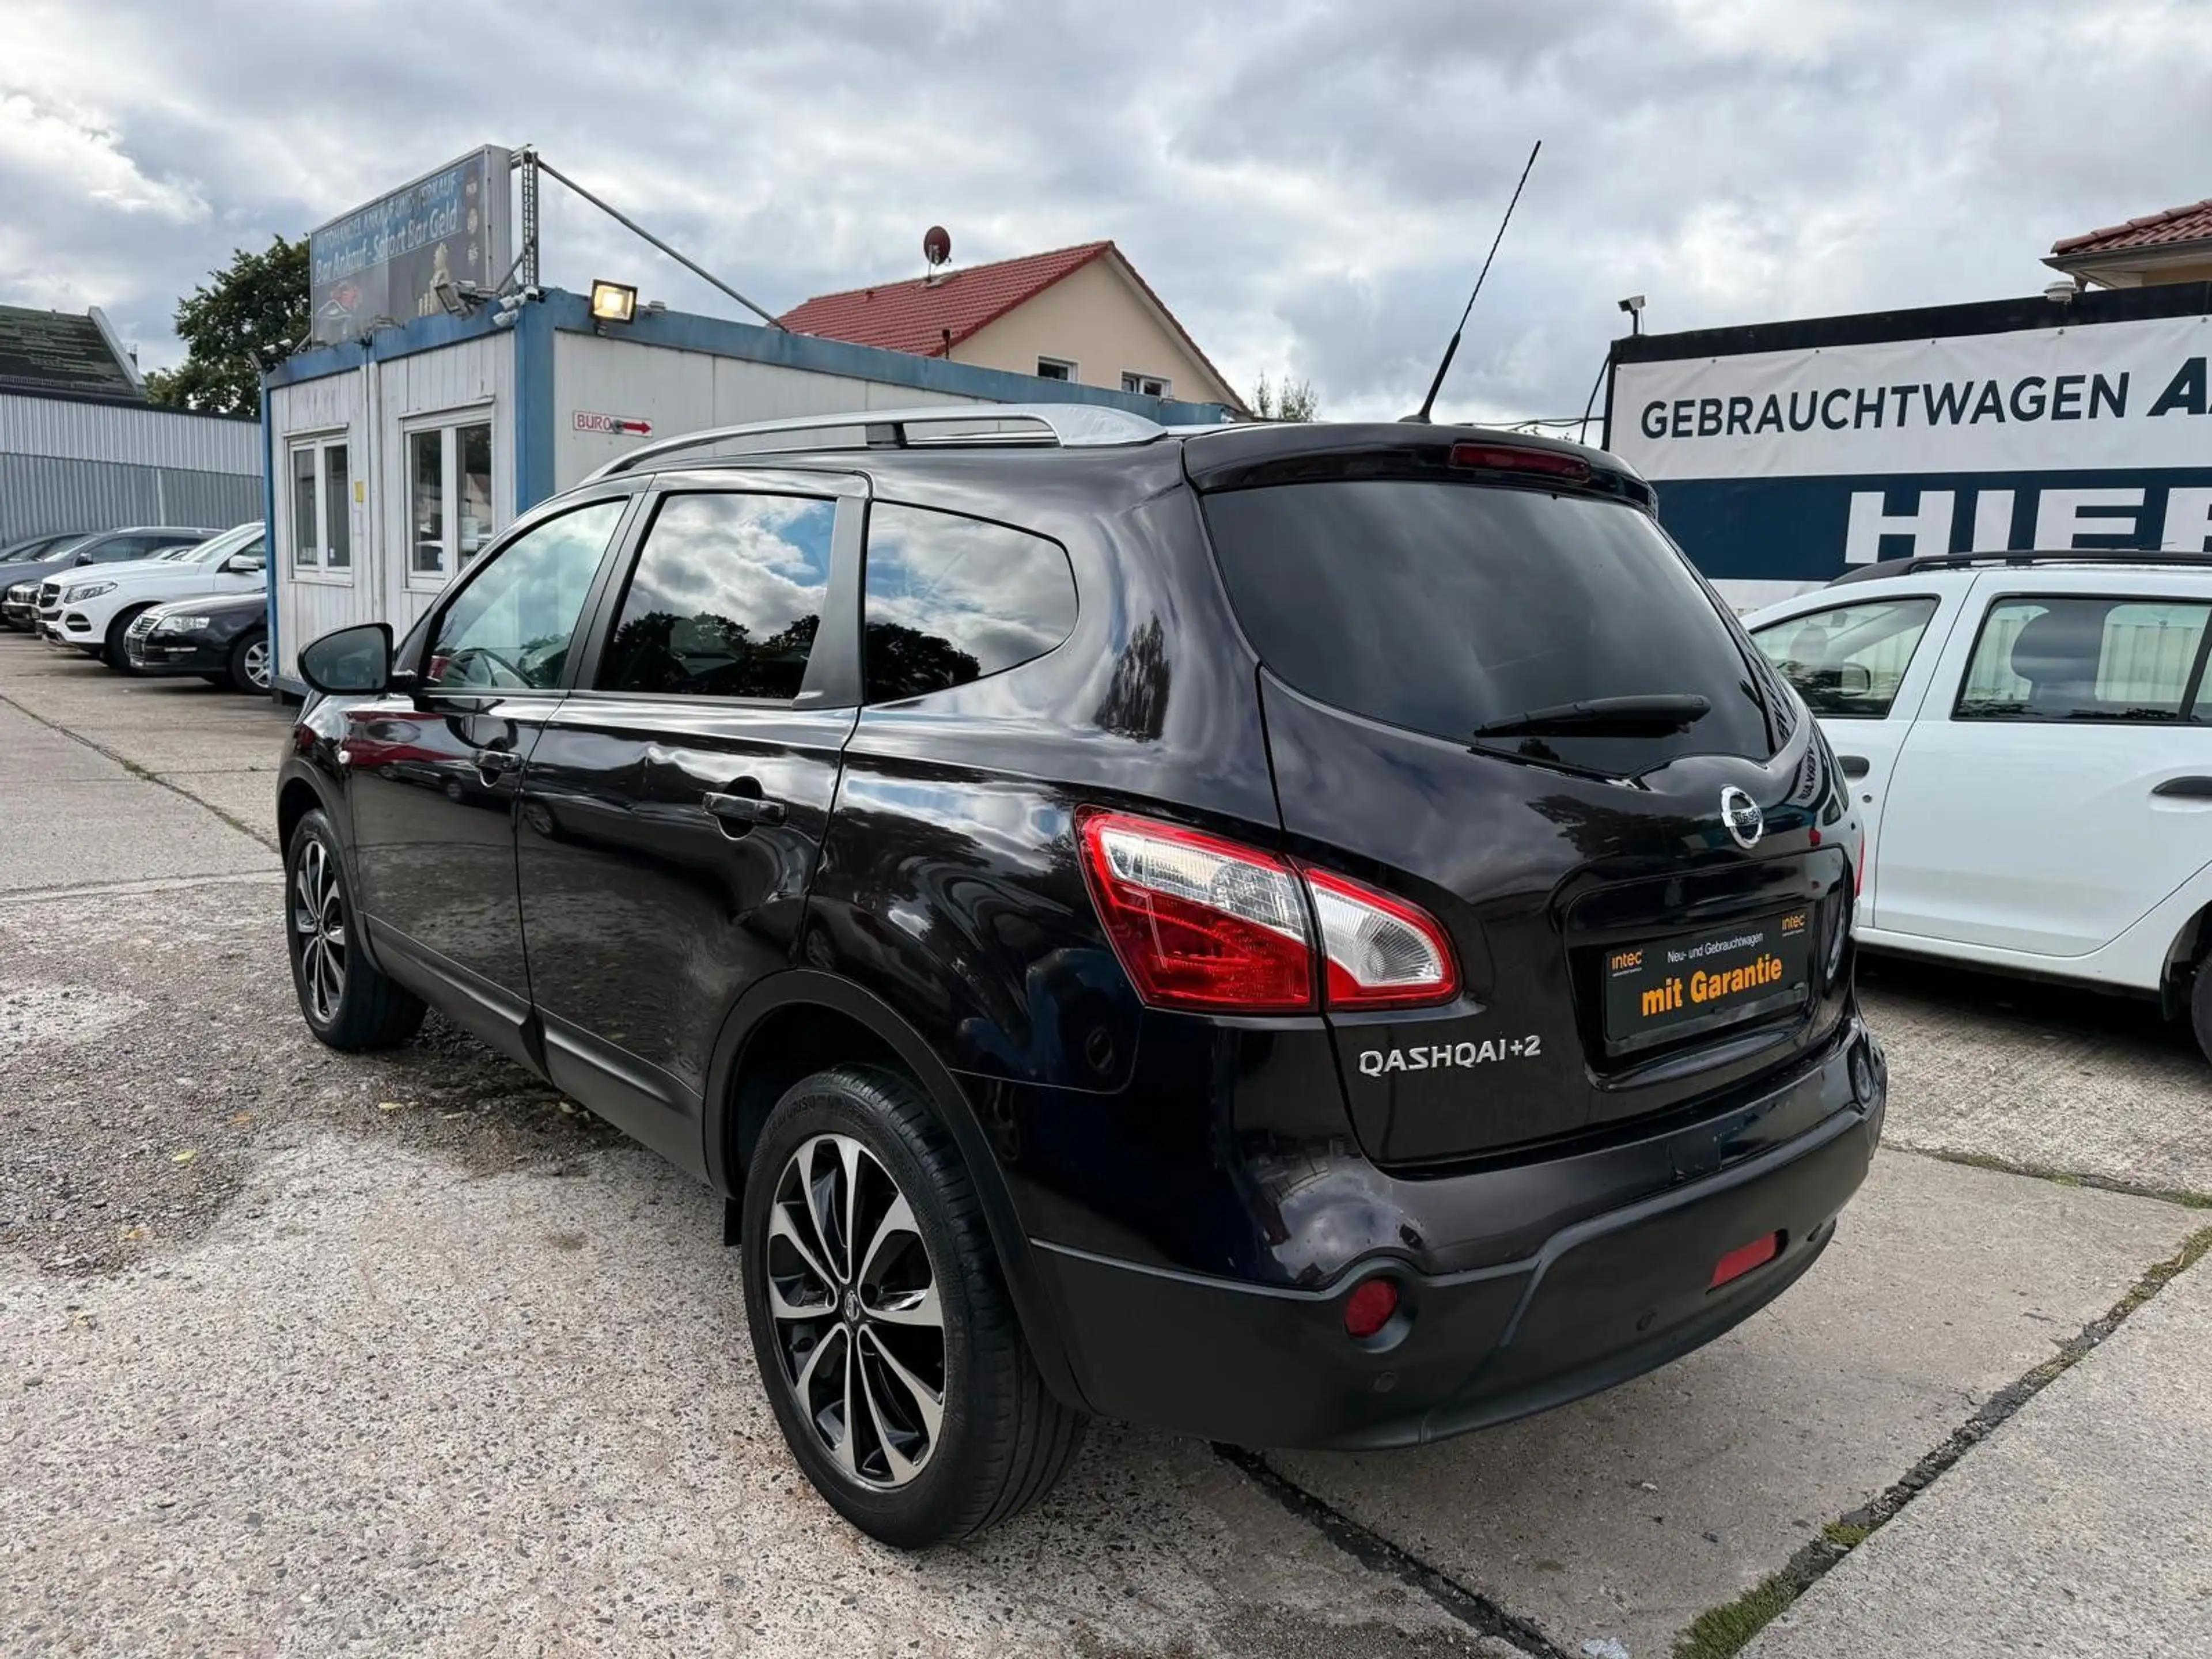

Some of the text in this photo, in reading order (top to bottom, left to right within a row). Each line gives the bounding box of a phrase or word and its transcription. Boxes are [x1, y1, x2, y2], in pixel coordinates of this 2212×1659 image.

[373, 225, 406, 263] Sofort
[408, 218, 428, 248] Bar
[430, 199, 457, 238] Geld
[1641, 372, 2130, 439] GEBRAUCHTWAGEN
[1667, 950, 1687, 963] Neu-
[1689, 943, 1703, 958] und
[1705, 932, 1764, 956] Gebrauchtwagen
[1642, 953, 1783, 1017] mit Garantie
